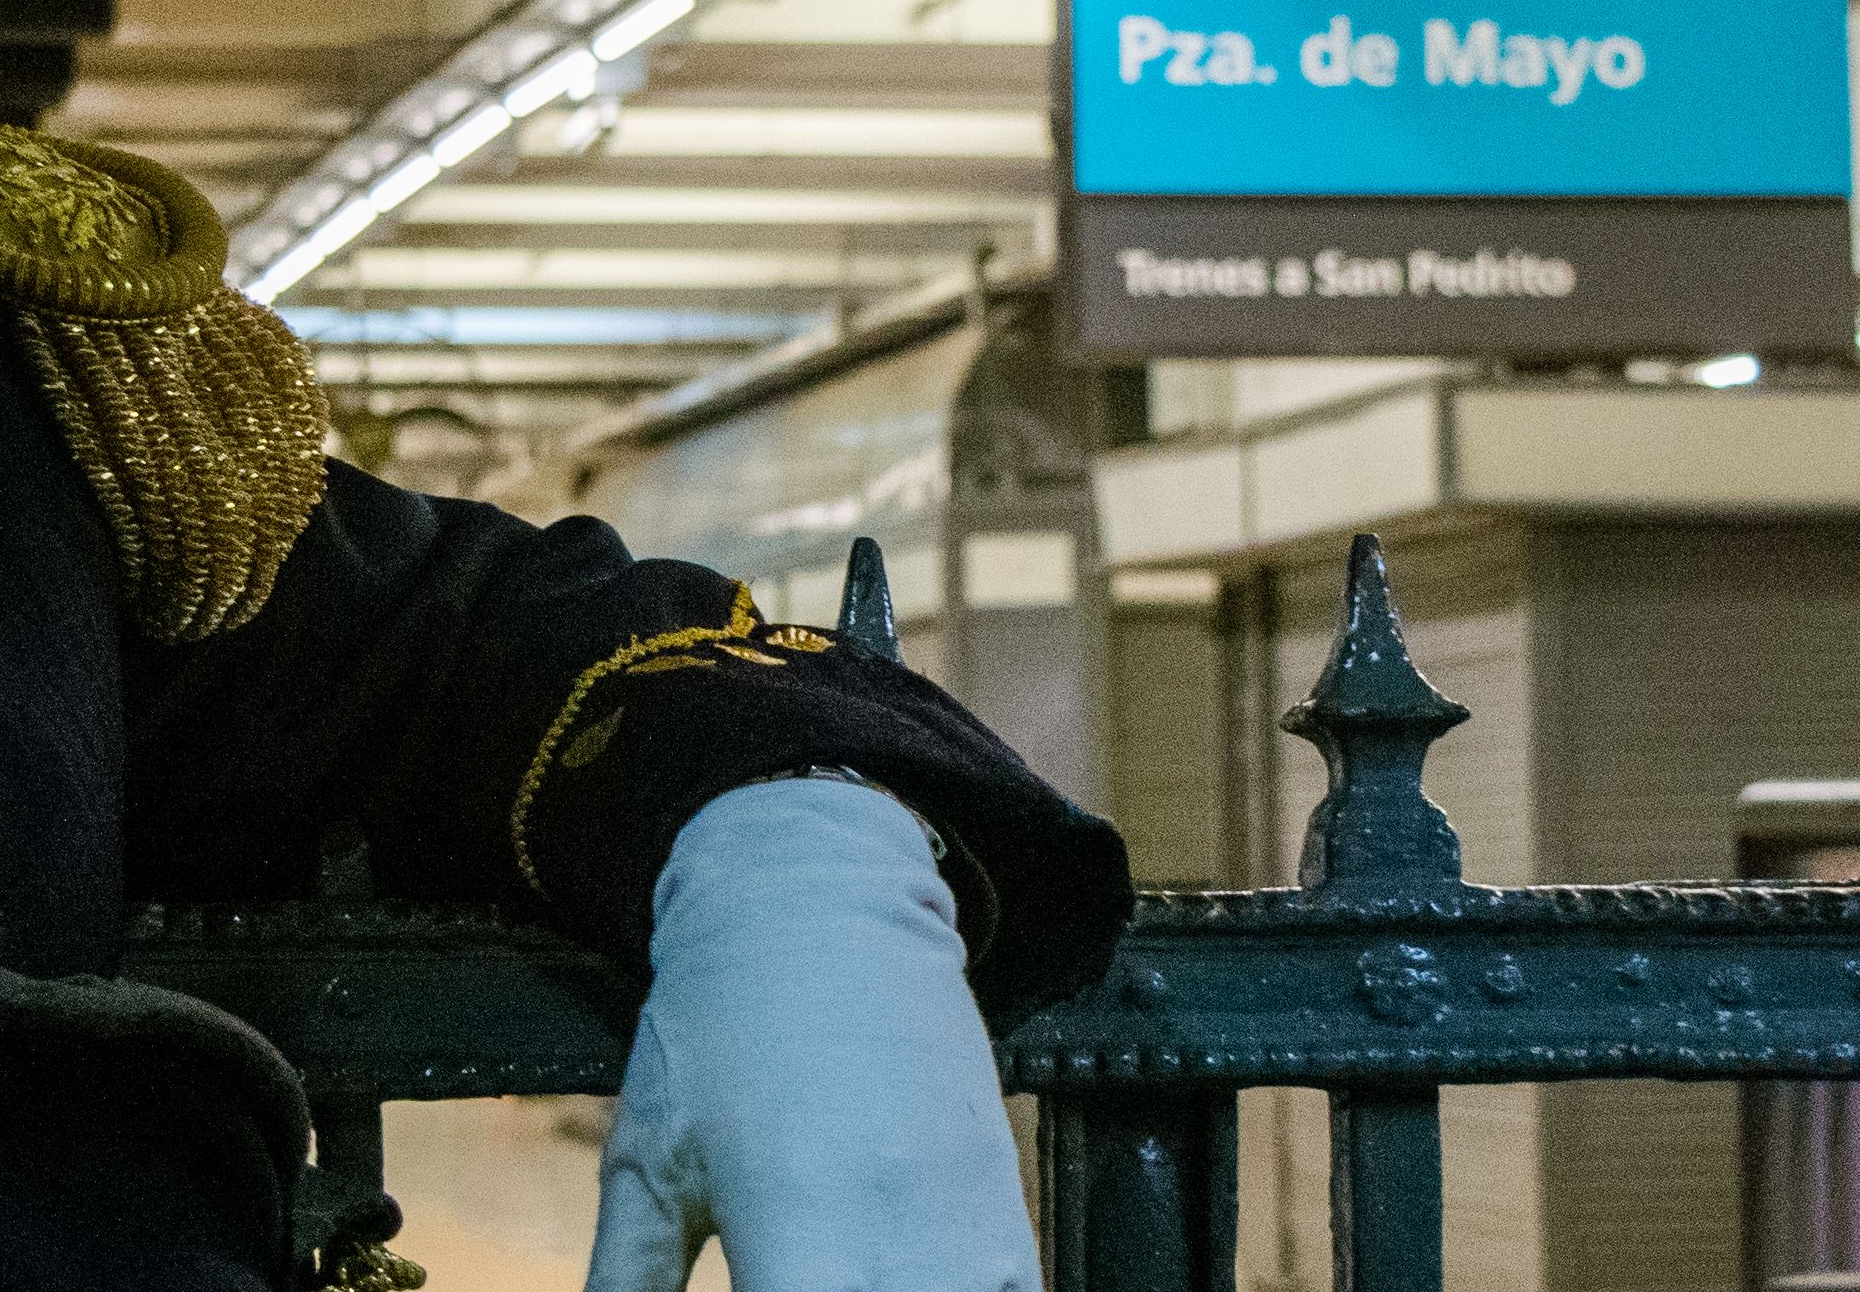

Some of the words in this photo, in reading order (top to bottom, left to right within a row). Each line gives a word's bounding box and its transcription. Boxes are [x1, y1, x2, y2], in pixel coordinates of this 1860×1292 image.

[1119, 15, 1278, 84] Pza.
[1300, 15, 1399, 87] de
[1424, 18, 1646, 106] Mayo
[1120, 250, 1266, 297] Trenes
[1274, 257, 1306, 297] a
[1314, 250, 1403, 297] San
[1409, 248, 1576, 298] Pedrito
